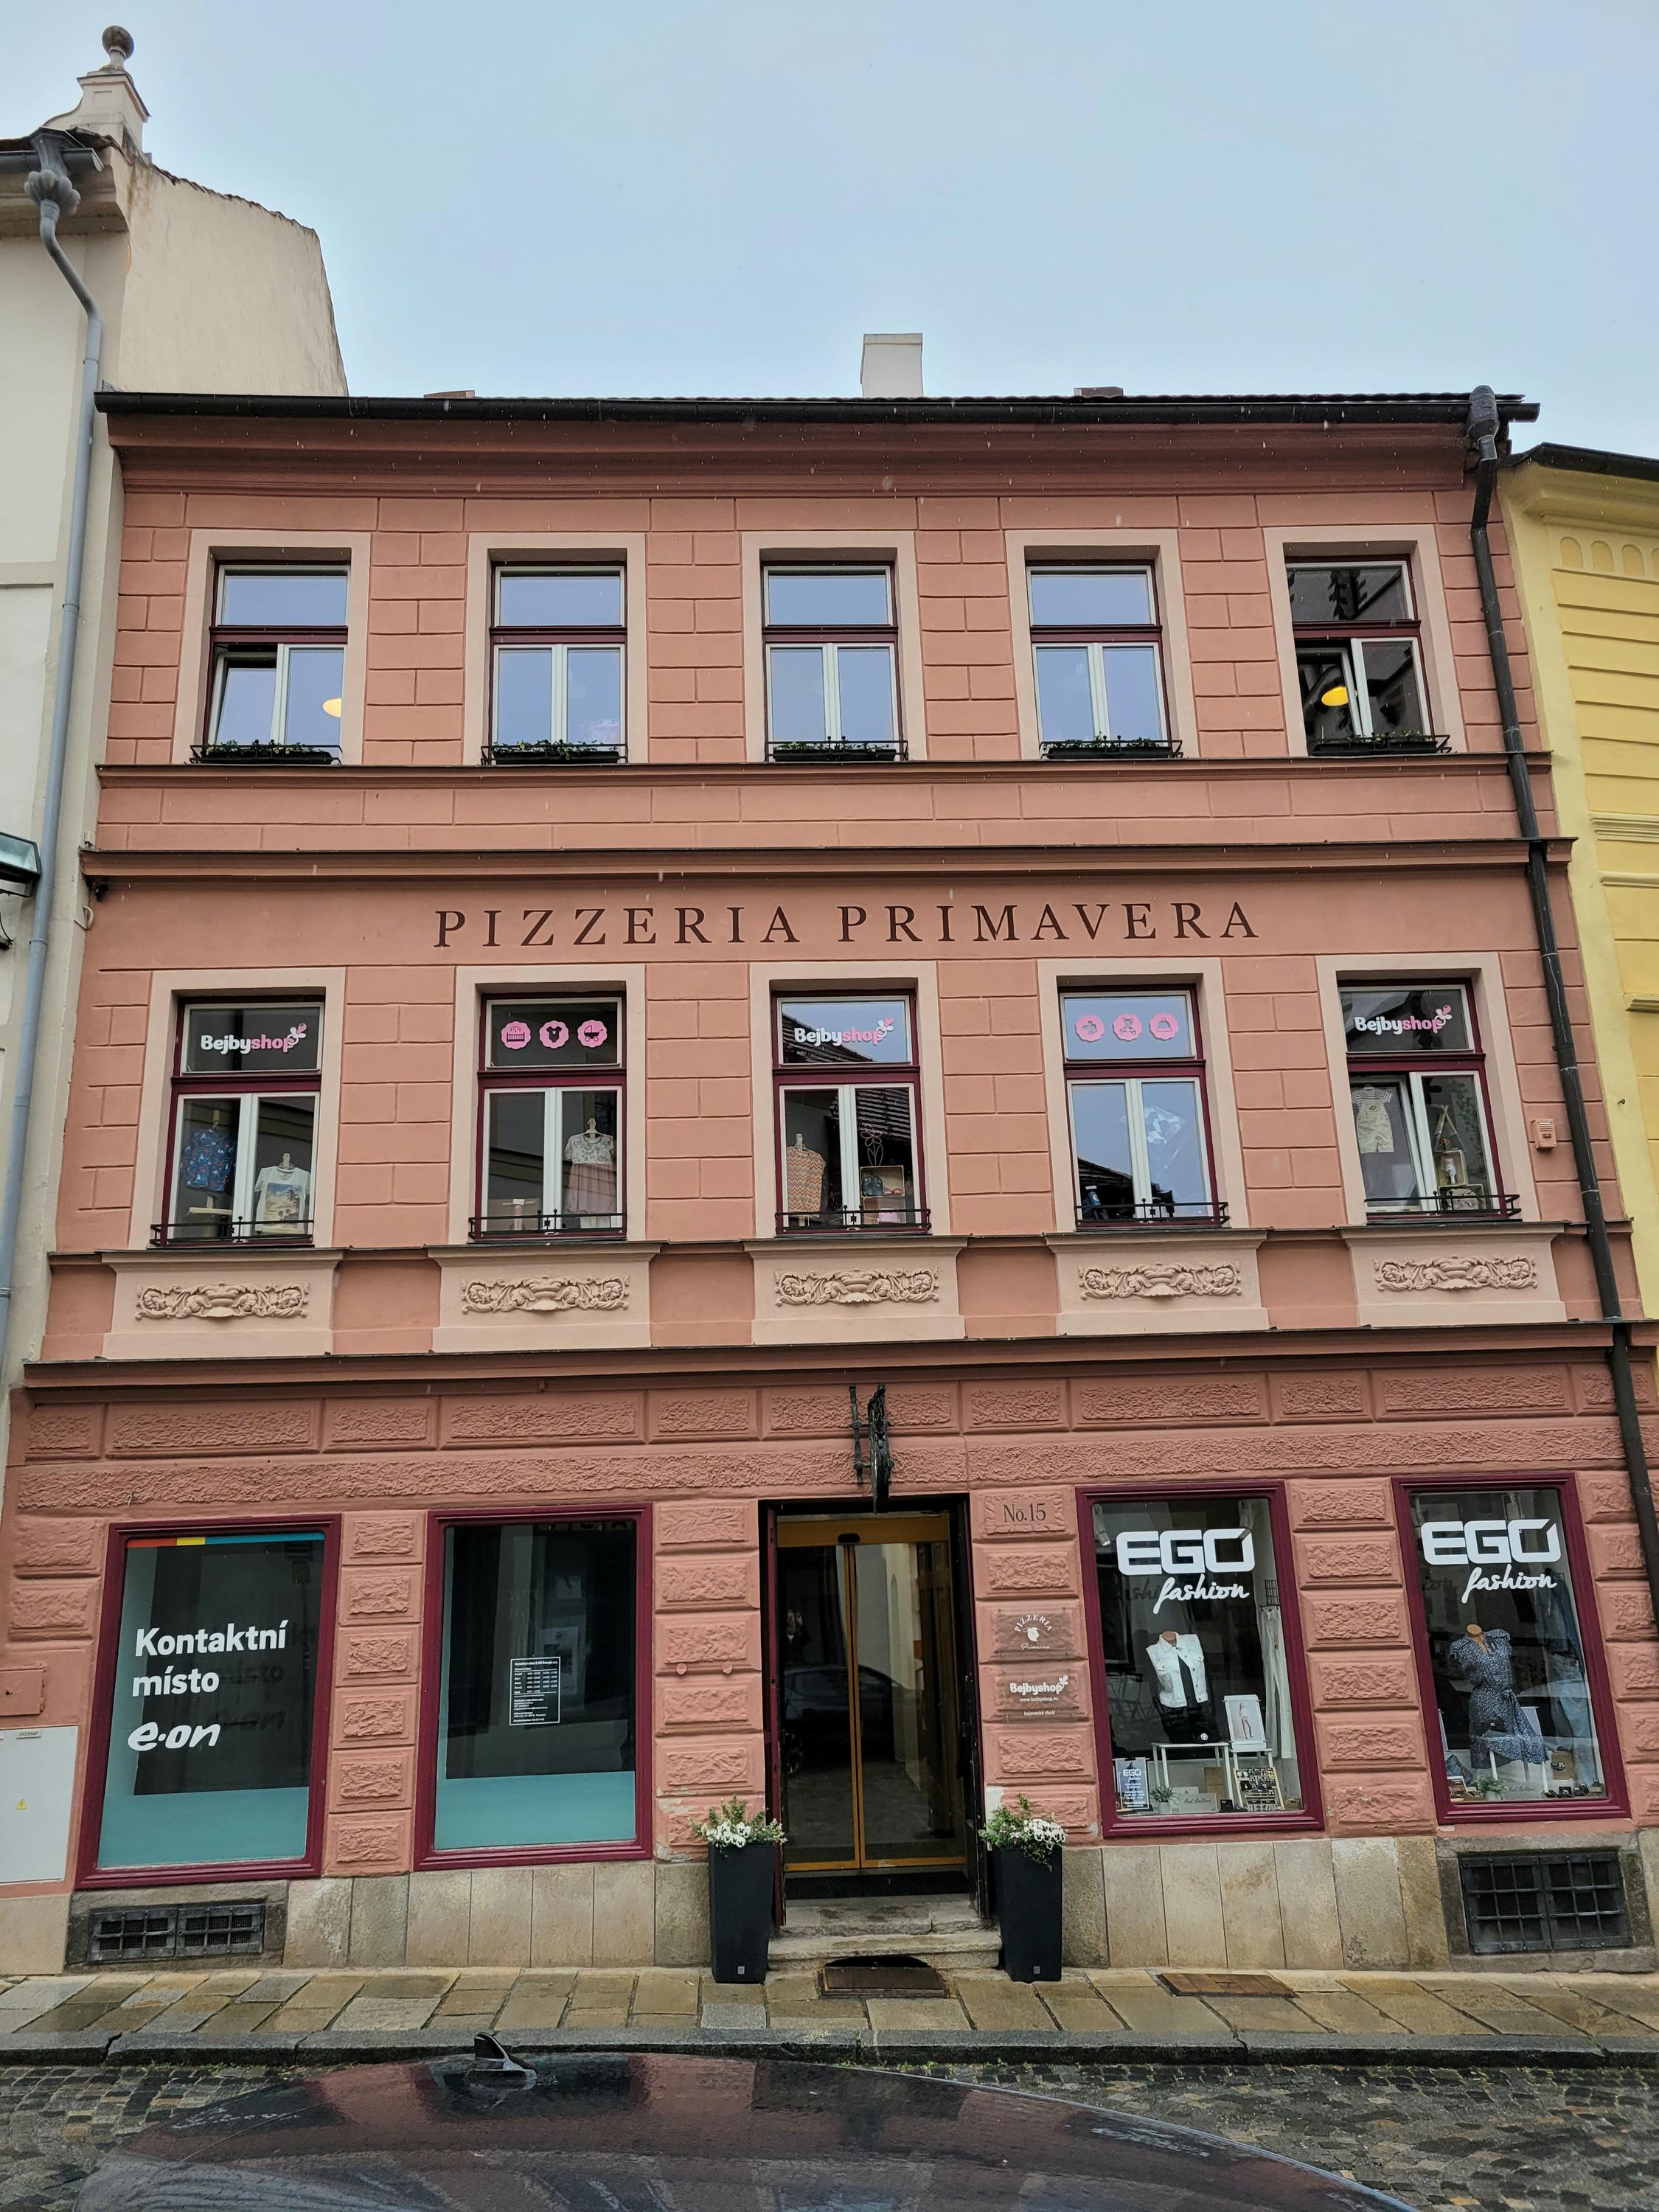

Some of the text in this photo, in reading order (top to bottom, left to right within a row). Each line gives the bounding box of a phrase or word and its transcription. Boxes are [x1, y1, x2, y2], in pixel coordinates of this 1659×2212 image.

[434, 901, 1259, 947] PIZZERIA PRIMAVERA
[794, 1027, 884, 1046] Bejbyshop
[1354, 1015, 1444, 1035] Bejbyshop
[201, 1034, 296, 1055] Bejbyshop
[1116, 1528, 1255, 1576] EGO
[1421, 1519, 1561, 1565] EGO
[1152, 1573, 1250, 1614] fashion
[1461, 1564, 1557, 1604] fashion
[136, 1620, 288, 1656] Kontaktní
[1014, 1613, 1054, 1632] PIZZERIA
[132, 1666, 220, 1697] místo
[1009, 1682, 1063, 1696] Bejbyshop
